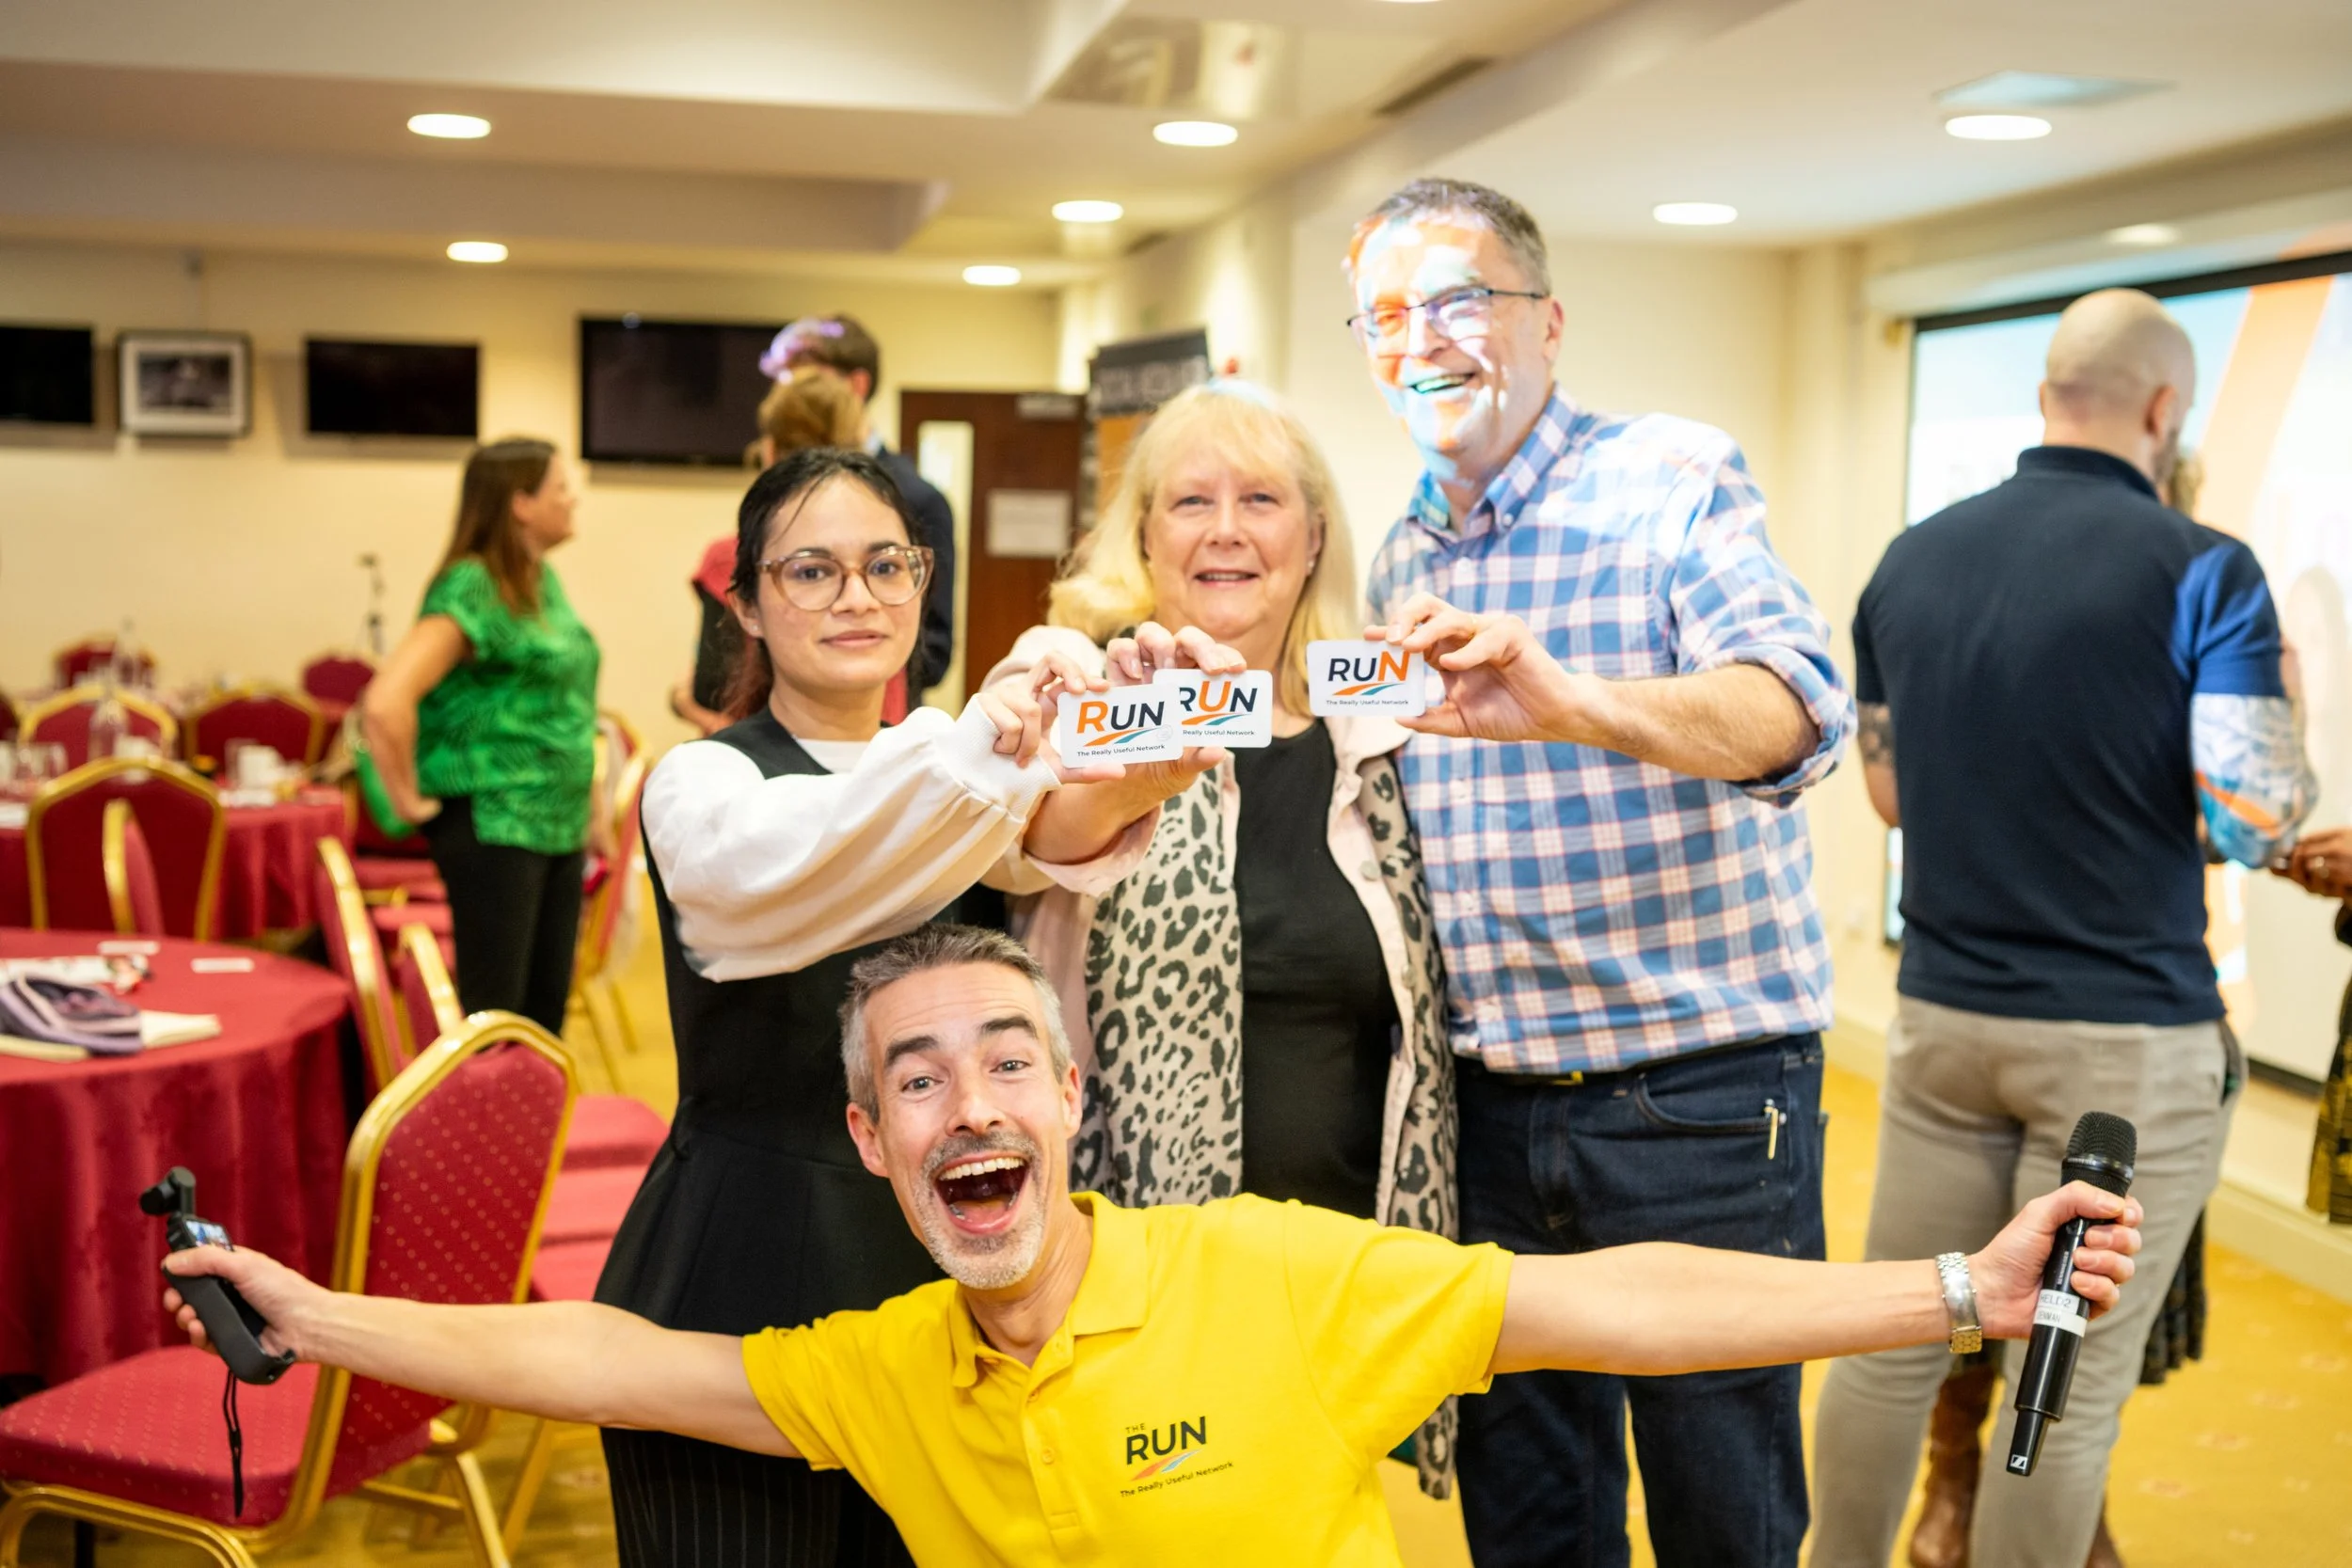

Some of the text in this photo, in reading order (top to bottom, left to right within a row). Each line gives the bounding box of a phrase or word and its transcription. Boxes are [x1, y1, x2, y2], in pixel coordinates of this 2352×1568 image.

[1327, 650, 1410, 682] RUN
[1179, 680, 1258, 712] RUN
[1076, 701, 1165, 734] RUN
[1125, 1423, 1146, 1434] THE
[1126, 1416, 1206, 1465] RUN
[1120, 1462, 1233, 1497] The Really Useful Network
